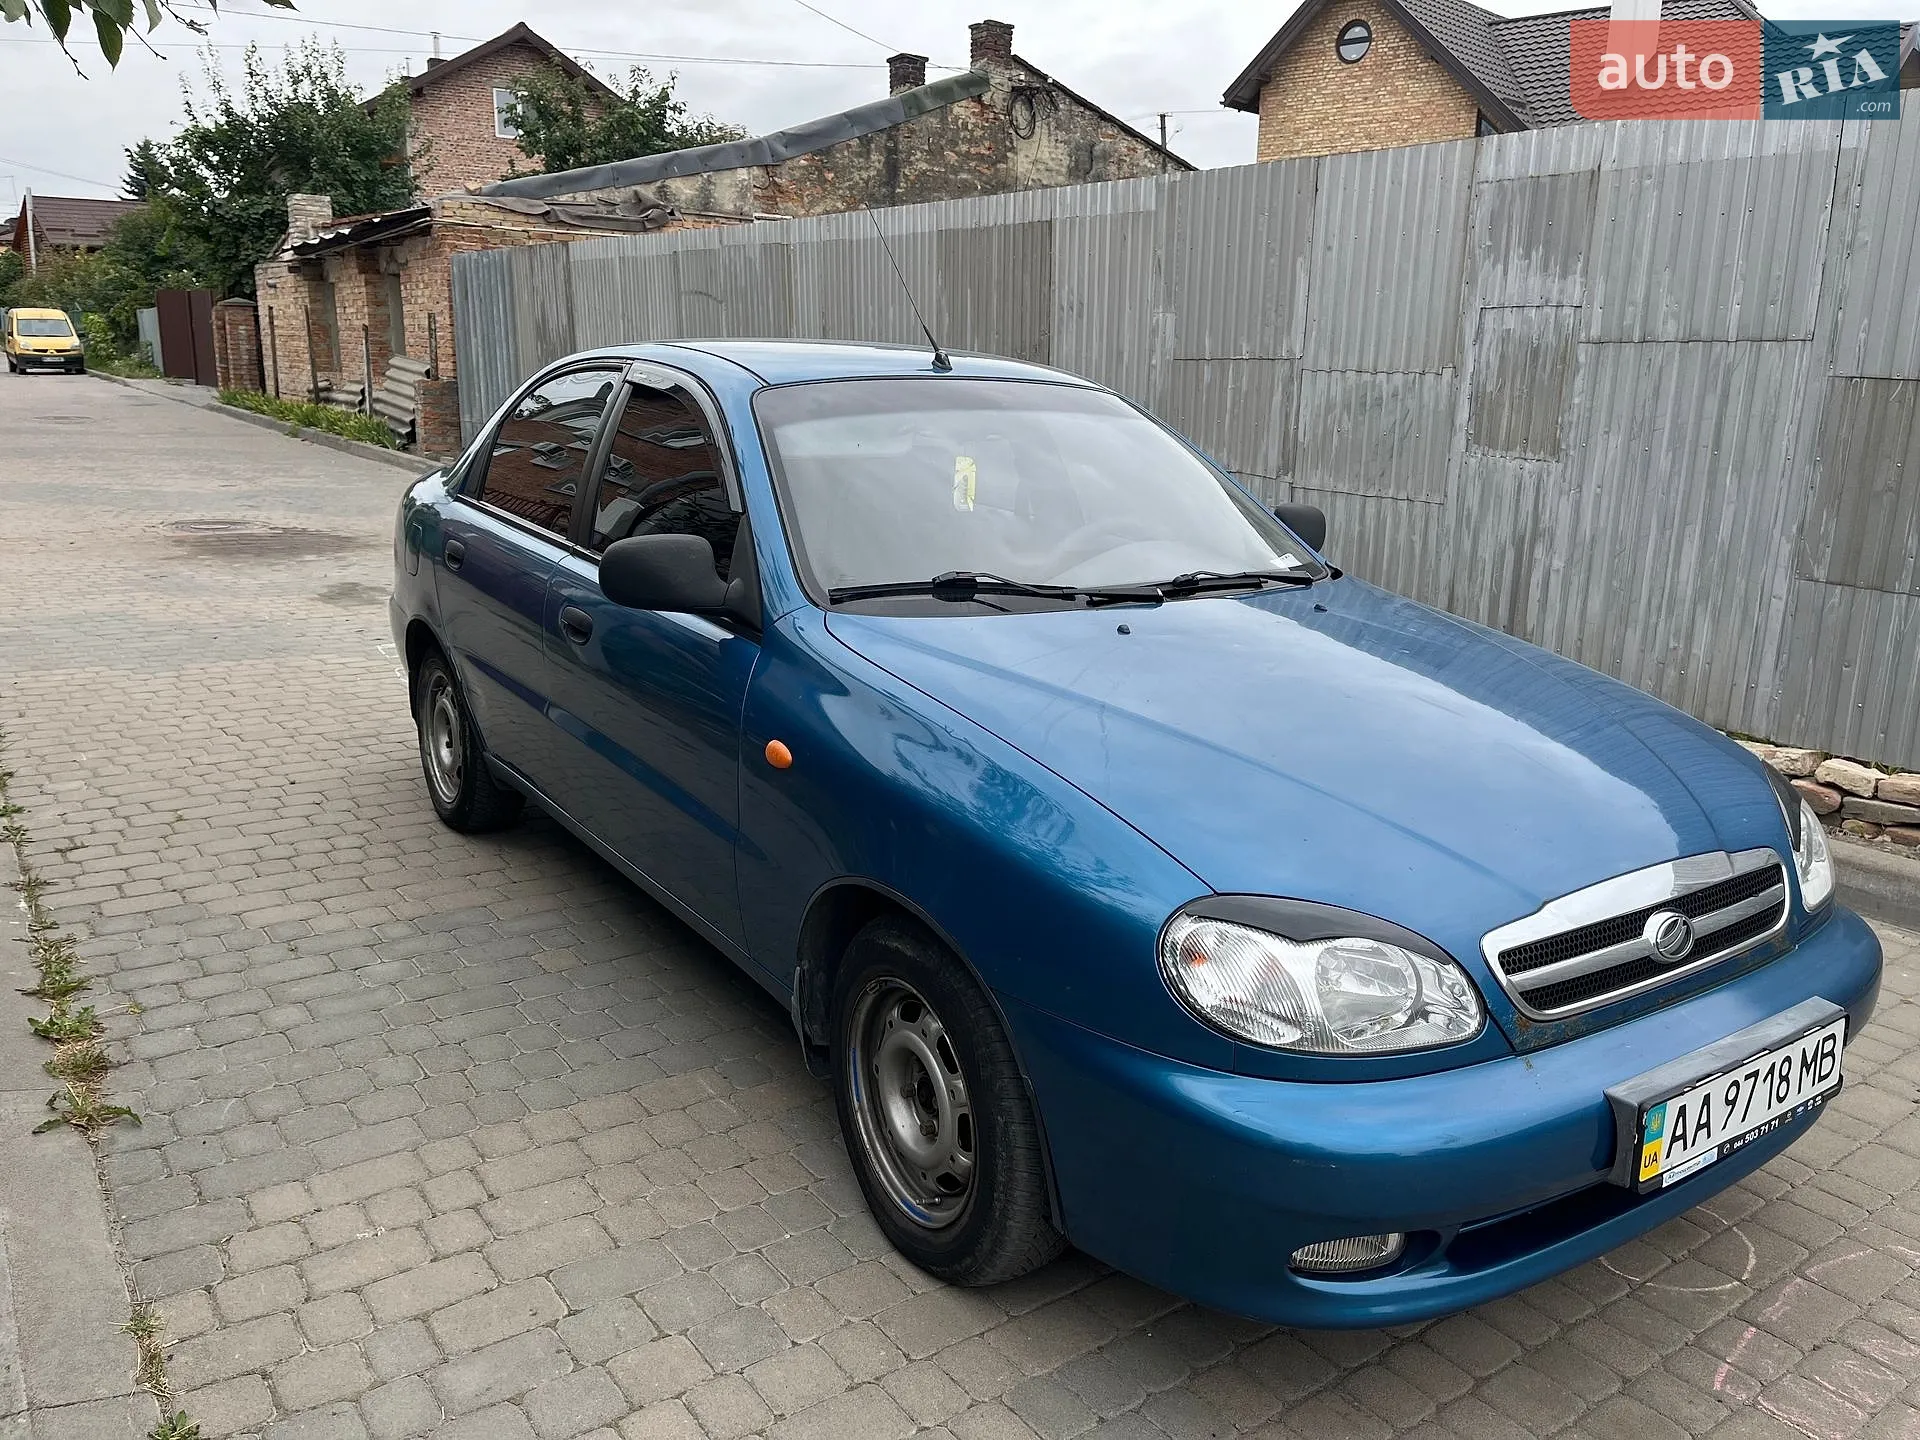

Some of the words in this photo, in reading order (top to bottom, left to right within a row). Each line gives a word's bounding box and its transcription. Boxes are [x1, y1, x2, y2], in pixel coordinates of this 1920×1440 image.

[1665, 1092, 1712, 1160] AA
[1721, 1055, 1792, 1132] 9718
[1797, 1032, 1838, 1095] MB
[1745, 1129, 1759, 1144] 503
[1760, 1123, 1769, 1136] 71
[1770, 1118, 1779, 1131] 71
[1643, 1150, 1659, 1169] UA
